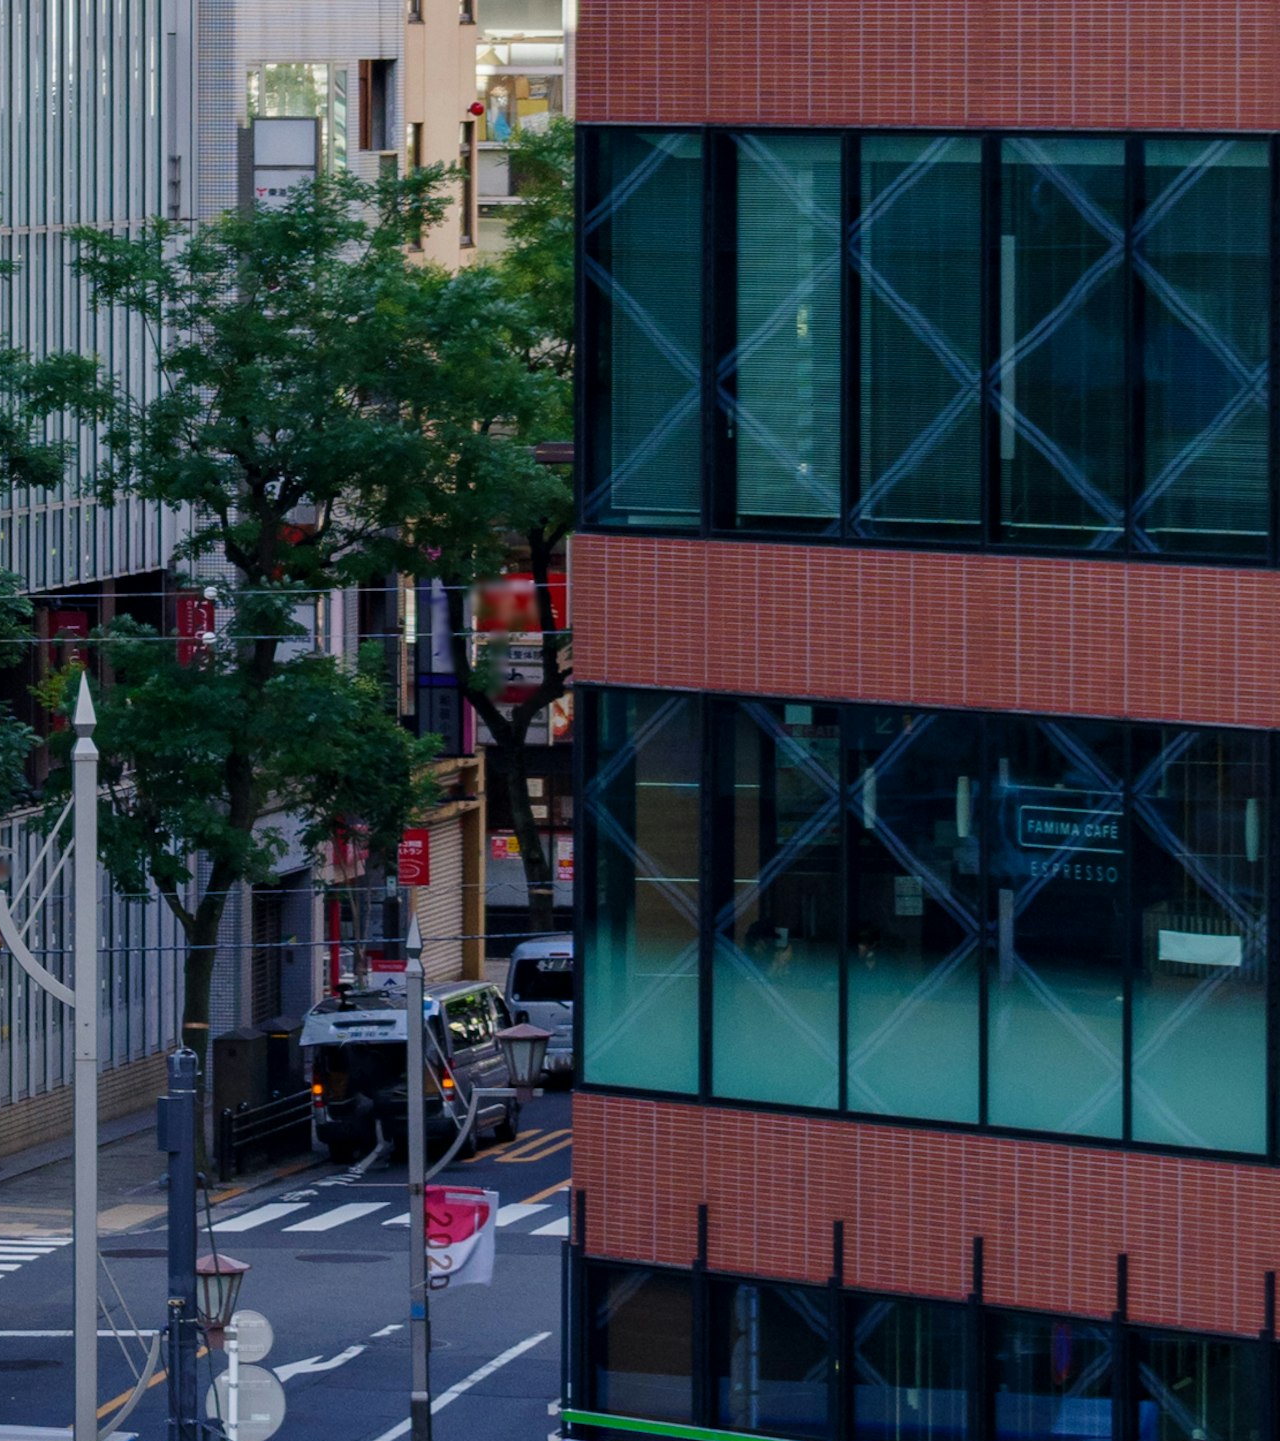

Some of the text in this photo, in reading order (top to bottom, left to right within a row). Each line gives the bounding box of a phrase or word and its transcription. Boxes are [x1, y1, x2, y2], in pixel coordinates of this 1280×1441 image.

[1027, 819, 1119, 839] FAMIMA CAFÉ
[1030, 861, 1117, 882] ESPRESSO
[426, 1211, 453, 1290] 2020
